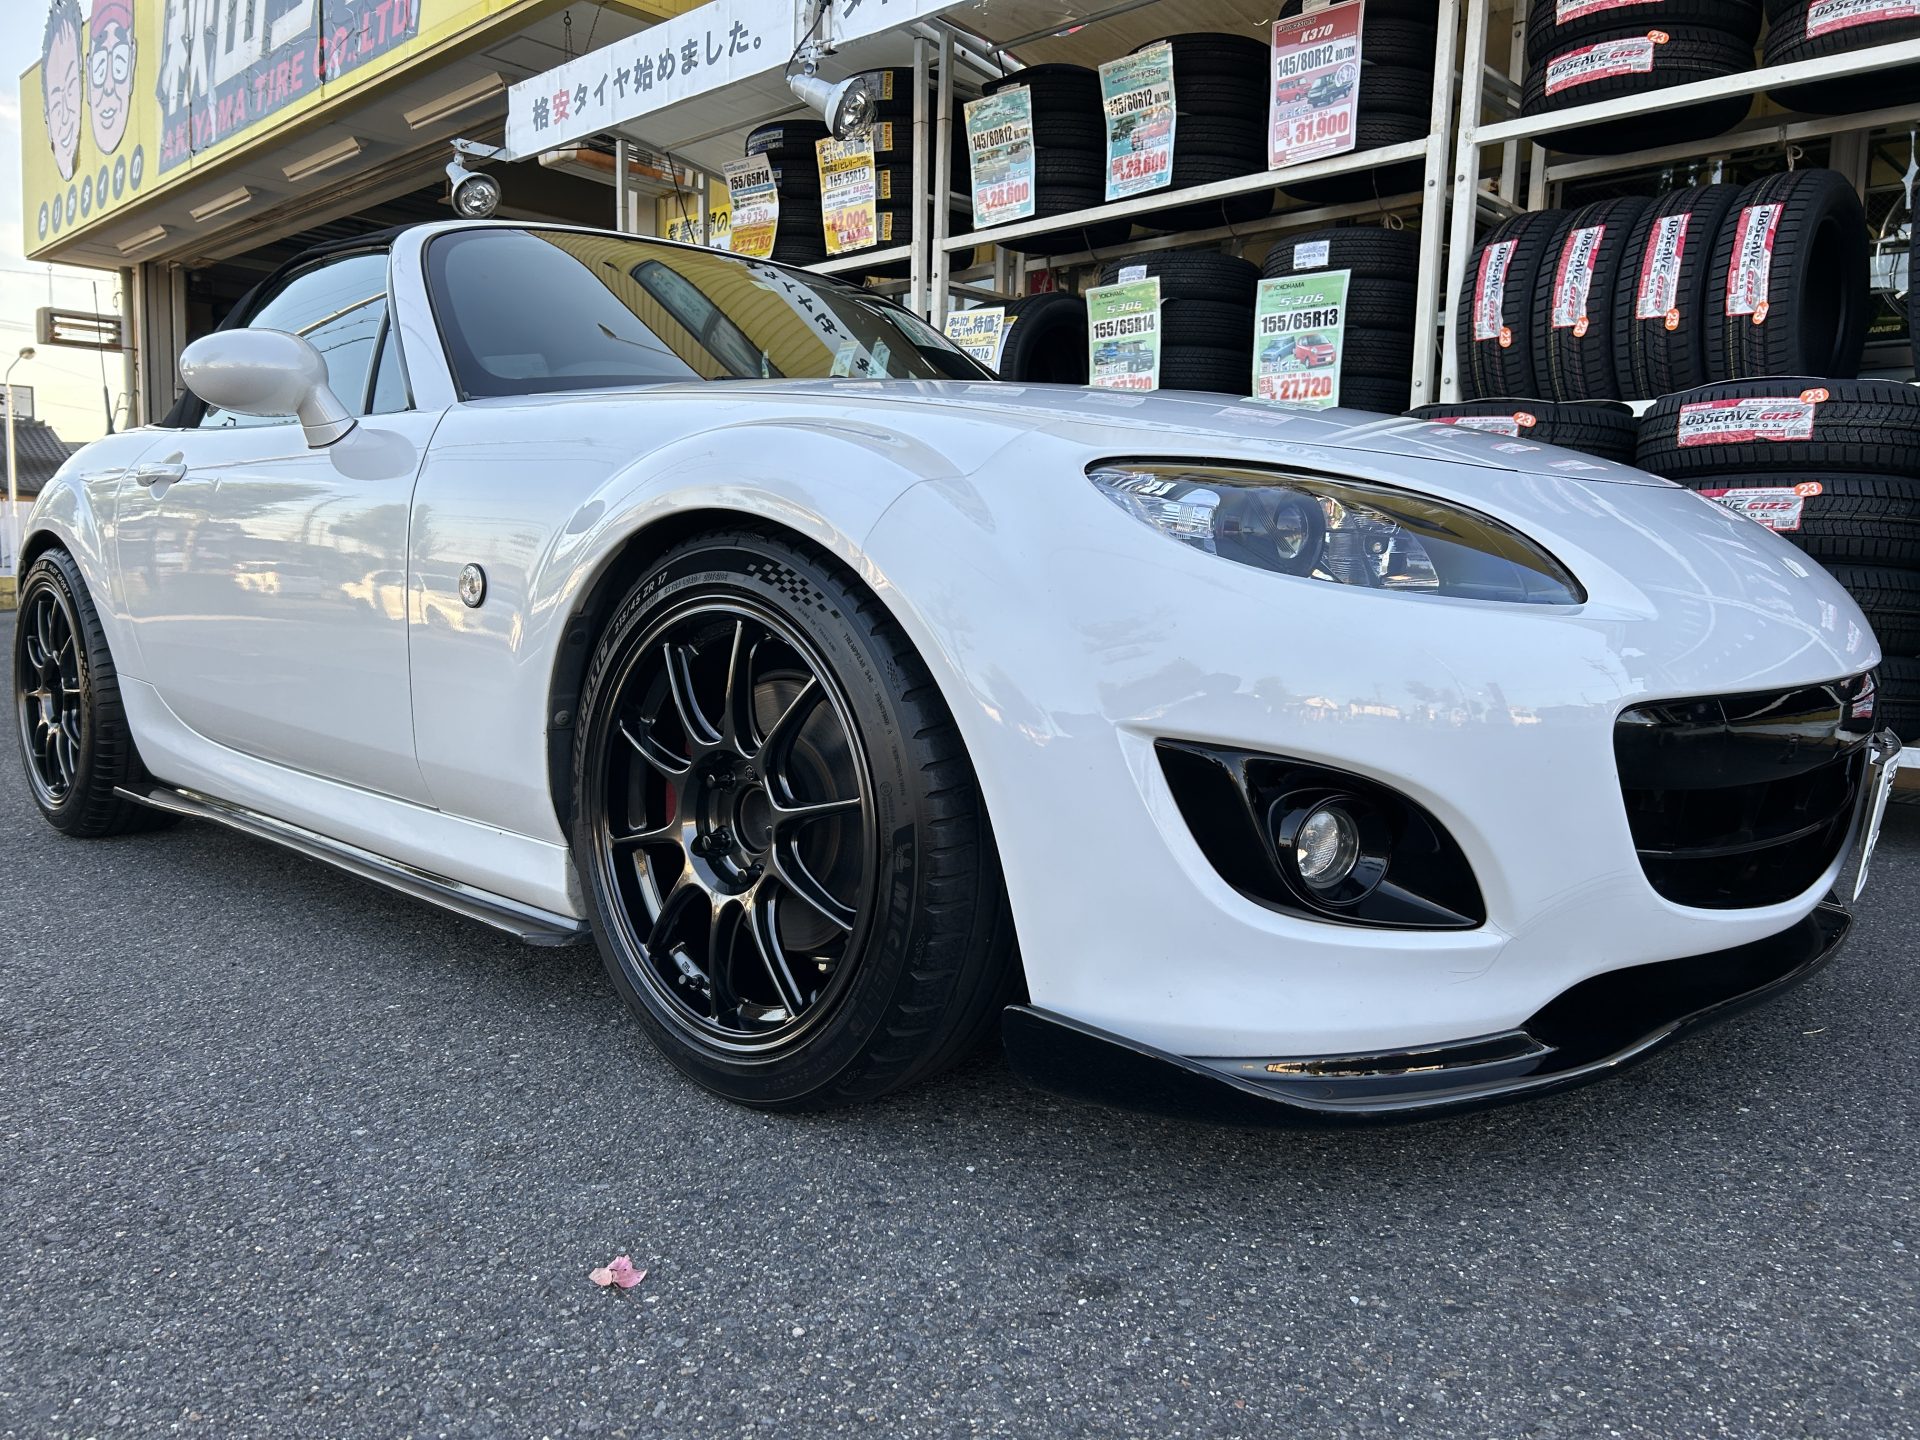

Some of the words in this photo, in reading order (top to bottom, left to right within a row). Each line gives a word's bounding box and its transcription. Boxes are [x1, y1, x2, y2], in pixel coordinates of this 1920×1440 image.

[1301, 24, 1334, 43] K370
[1652, 31, 1665, 43] 23
[1278, 45, 1334, 77] 145/80R12
[1551, 52, 1607, 76] OBSERVE
[532, 20, 762, 132] 格安タイヤ始めました。
[162, 87, 247, 162] AKIYAMA
[254, 51, 305, 113] TIRE
[973, 125, 1013, 151] 145/80R12
[730, 169, 770, 191] 155/65R14
[829, 168, 866, 188] 165/55R15
[1660, 219, 1679, 272] OBSERVE
[1749, 210, 1770, 268] OBSERVE
[1572, 233, 1593, 283] OBSERVE
[1490, 247, 1507, 297] OBSERVE
[1273, 282, 1305, 291] YOKOHAMA
[1106, 301, 1142, 314] S306
[1278, 293, 1325, 306] S306
[1262, 308, 1339, 333] 155/65R13
[1668, 312, 1678, 327] 23
[1755, 305, 1767, 320] 23
[1094, 314, 1155, 339] 155/65R14
[1576, 321, 1588, 336] 23
[1501, 331, 1510, 343] 23
[1806, 389, 1825, 402] 23
[1517, 413, 1533, 426] 23
[1686, 409, 1757, 426] OBSERVE
[1760, 411, 1803, 421] GIZ2
[1799, 483, 1818, 496] 23
[1747, 502, 1792, 510] GIZ2
[573, 640, 609, 777] MICHELIN
[614, 593, 641, 635] 215/45
[642, 581, 655, 598] ZR
[658, 571, 668, 585] 17
